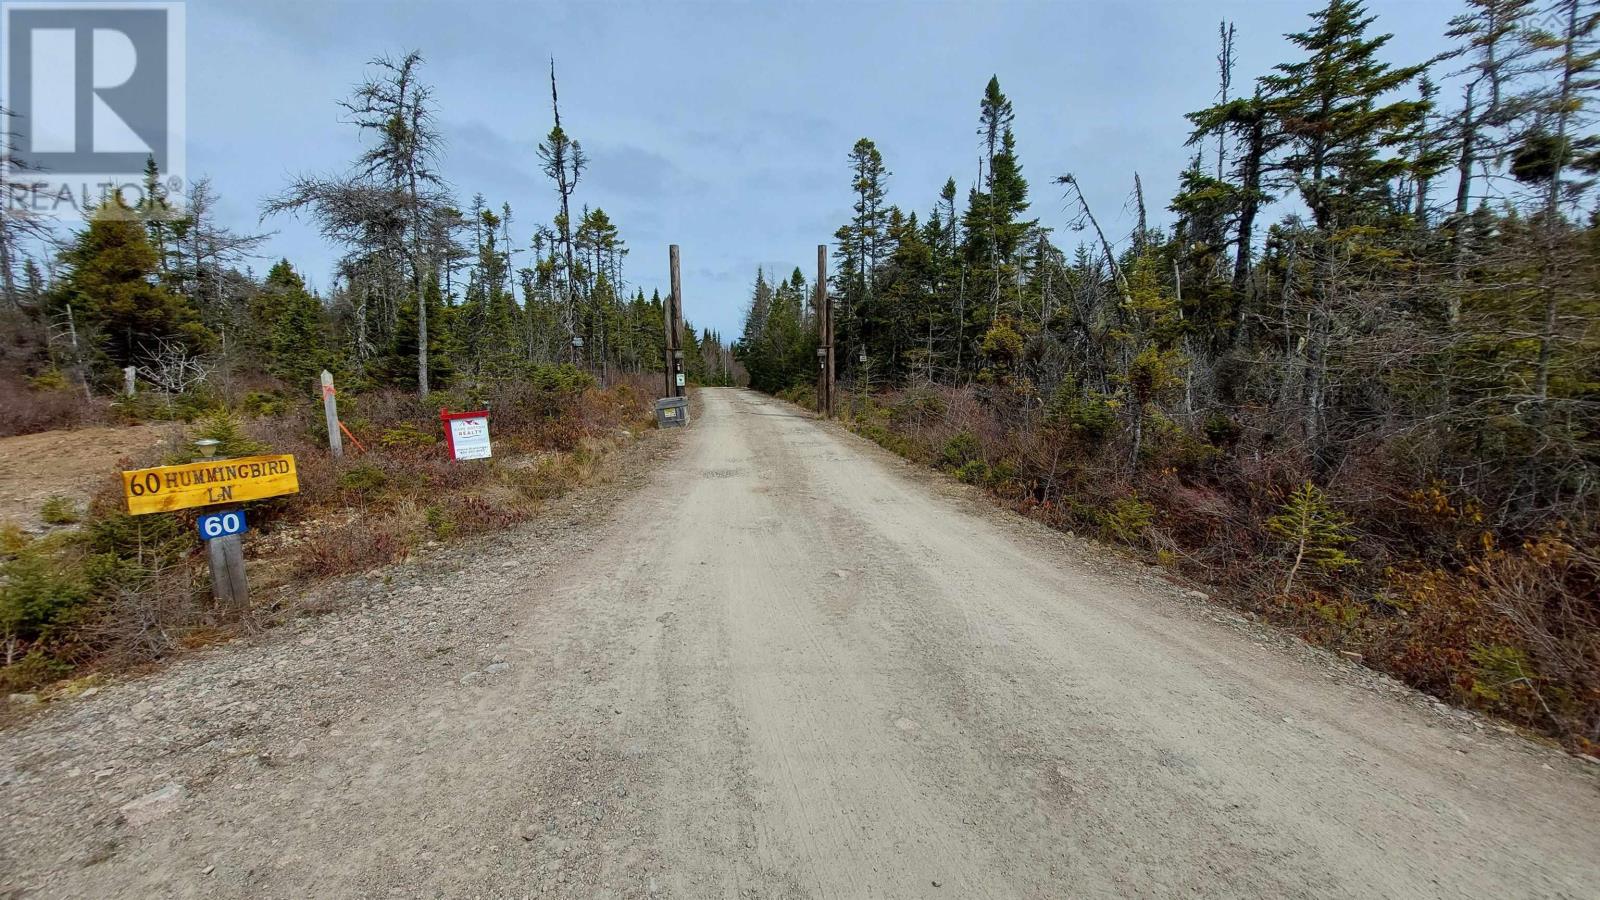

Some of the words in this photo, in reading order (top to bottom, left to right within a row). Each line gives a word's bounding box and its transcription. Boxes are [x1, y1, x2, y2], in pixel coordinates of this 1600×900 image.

[130, 473, 160, 496] 60
[165, 460, 289, 488] HUMMINGBIRD
[208, 485, 233, 503] LN
[205, 513, 240, 536] 60
